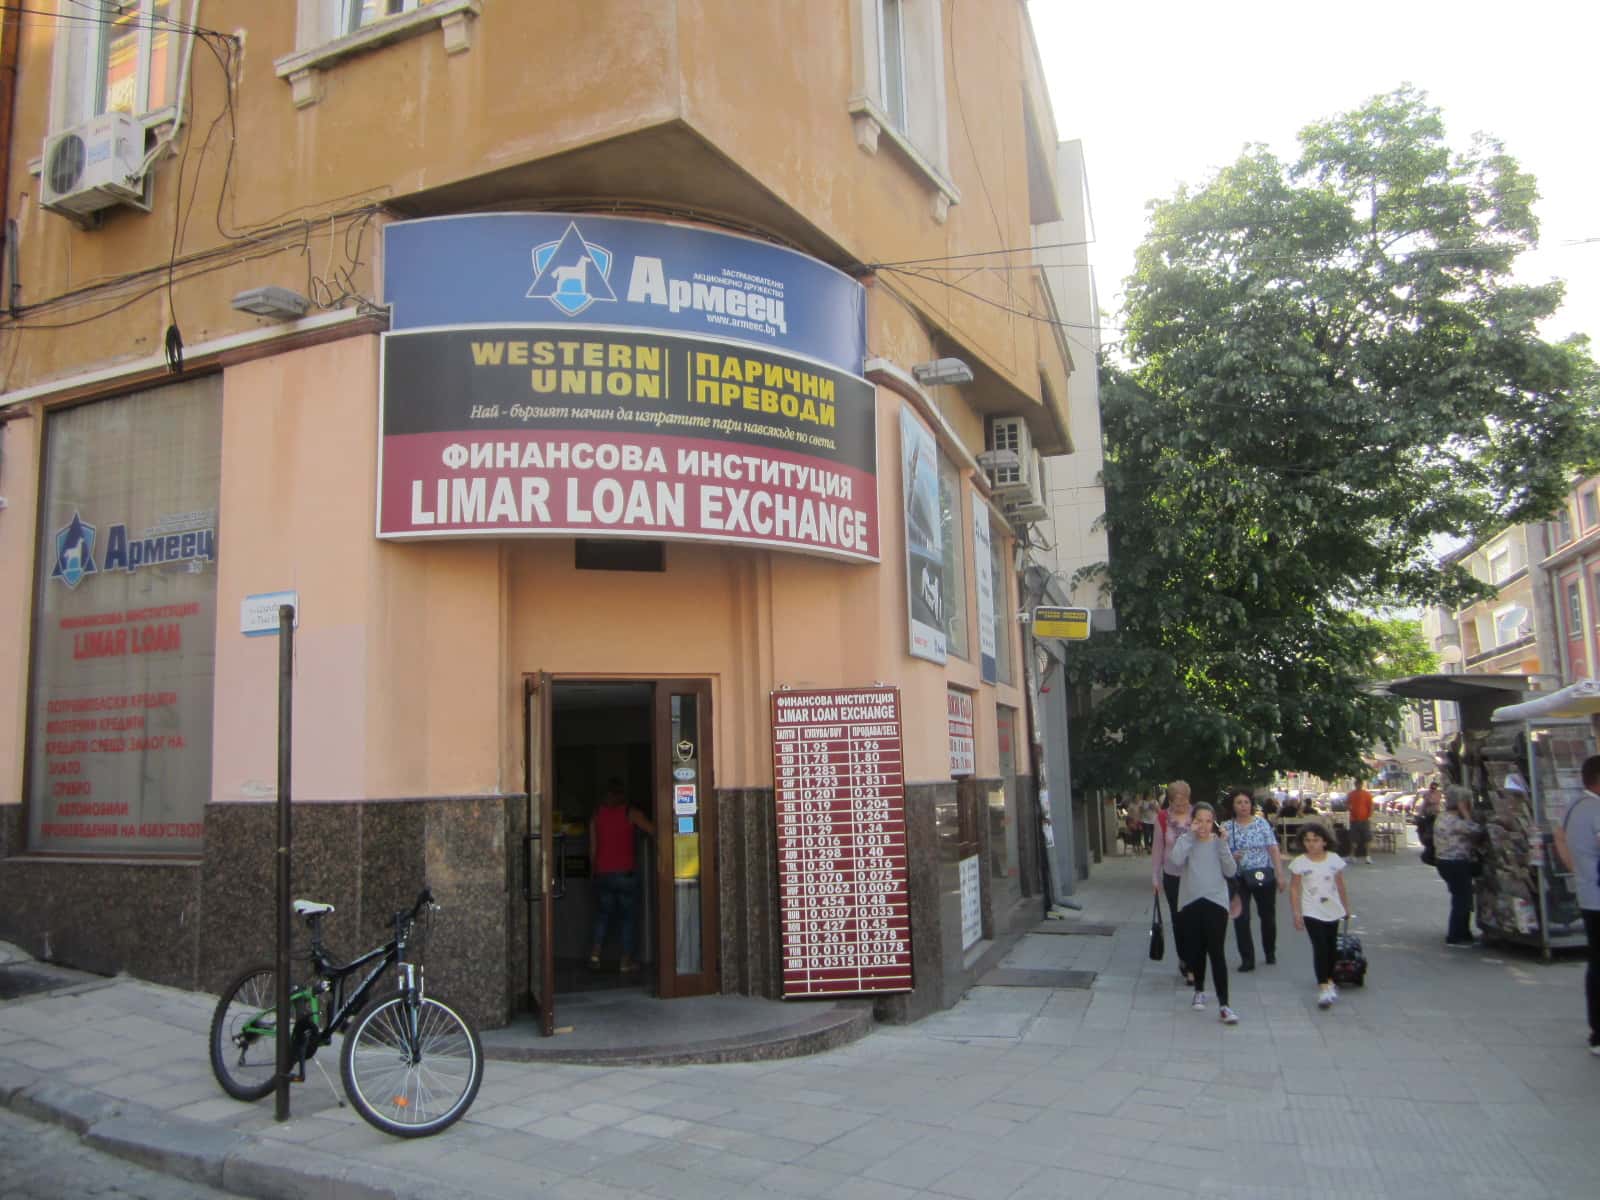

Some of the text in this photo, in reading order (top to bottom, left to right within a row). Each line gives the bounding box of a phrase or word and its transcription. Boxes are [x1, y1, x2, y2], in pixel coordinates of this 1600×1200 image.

[693, 272, 784, 298] АКЦИОНЕРНО ДРУЖЕСТВО
[627, 256, 787, 334] Армеец
[706, 314, 776, 336] www.armeec.bg
[471, 341, 660, 371] WESTERN
[696, 352, 835, 402] ПАРИЧНИ
[531, 369, 660, 399] UNION
[696, 380, 835, 428] ПРЕВОДИ
[470, 404, 499, 419] Най
[510, 404, 569, 422] бързият
[570, 406, 614, 421] начин
[616, 406, 633, 422] да
[635, 410, 711, 428] изпратите
[713, 417, 743, 434] пари
[744, 422, 795, 441] навсякъде
[796, 433, 808, 442] по
[442, 442, 852, 500] ФИНАНСОВА ИНСТИТУЦИЯ
[411, 476, 868, 552] LIMAR LOAN EXCHANGE
[103, 522, 215, 572] Армеец
[72, 624, 181, 660] LIMAR LOAN
[778, 694, 894, 706] ФИНАНСОВА ИНСТИТУЦИЯ
[778, 706, 895, 722] LIMAR LOAN EXCHANGE
[1423, 708, 1432, 728] VIP
[803, 743, 828, 752] 1.95
[854, 741, 879, 750] 1.96
[803, 755, 828, 764] 1.78
[854, 753, 879, 762] 1.80
[803, 766, 836, 777] 2.283
[854, 765, 878, 774] 2.31
[805, 778, 838, 787] 1.793
[856, 776, 887, 785] 1.831
[805, 790, 836, 800] 0.201
[855, 788, 879, 797] 0.21
[805, 802, 831, 811] 0.19
[855, 800, 888, 809] 0.204
[806, 814, 831, 824] 0.26
[856, 812, 888, 821] 0.264
[808, 826, 832, 835] 1.29
[858, 824, 882, 833] 1.34
[806, 838, 840, 847] 0.016
[857, 835, 890, 845] 0.018
[808, 849, 841, 858] 1.298
[858, 847, 884, 857] 1.40
[808, 861, 834, 871] 0.50
[858, 859, 892, 869] 0.516
[807, 873, 842, 883] 0.070
[858, 871, 893, 880] 0.075
[808, 885, 850, 895] 0.0062
[860, 883, 899, 893] 0.0067
[809, 897, 845, 907] 0.454
[860, 895, 886, 905] 0.48
[810, 908, 851, 919] 0.0307
[860, 907, 894, 917] 0.033
[810, 921, 845, 931] 0.427
[861, 920, 887, 929] 0.45
[811, 933, 845, 943] 0.261
[861, 931, 896, 942] 0.278
[811, 945, 855, 956] 0.0159
[862, 943, 904, 953] 0.0178
[812, 957, 855, 967] 0.0315
[862, 956, 896, 965] 0.034
